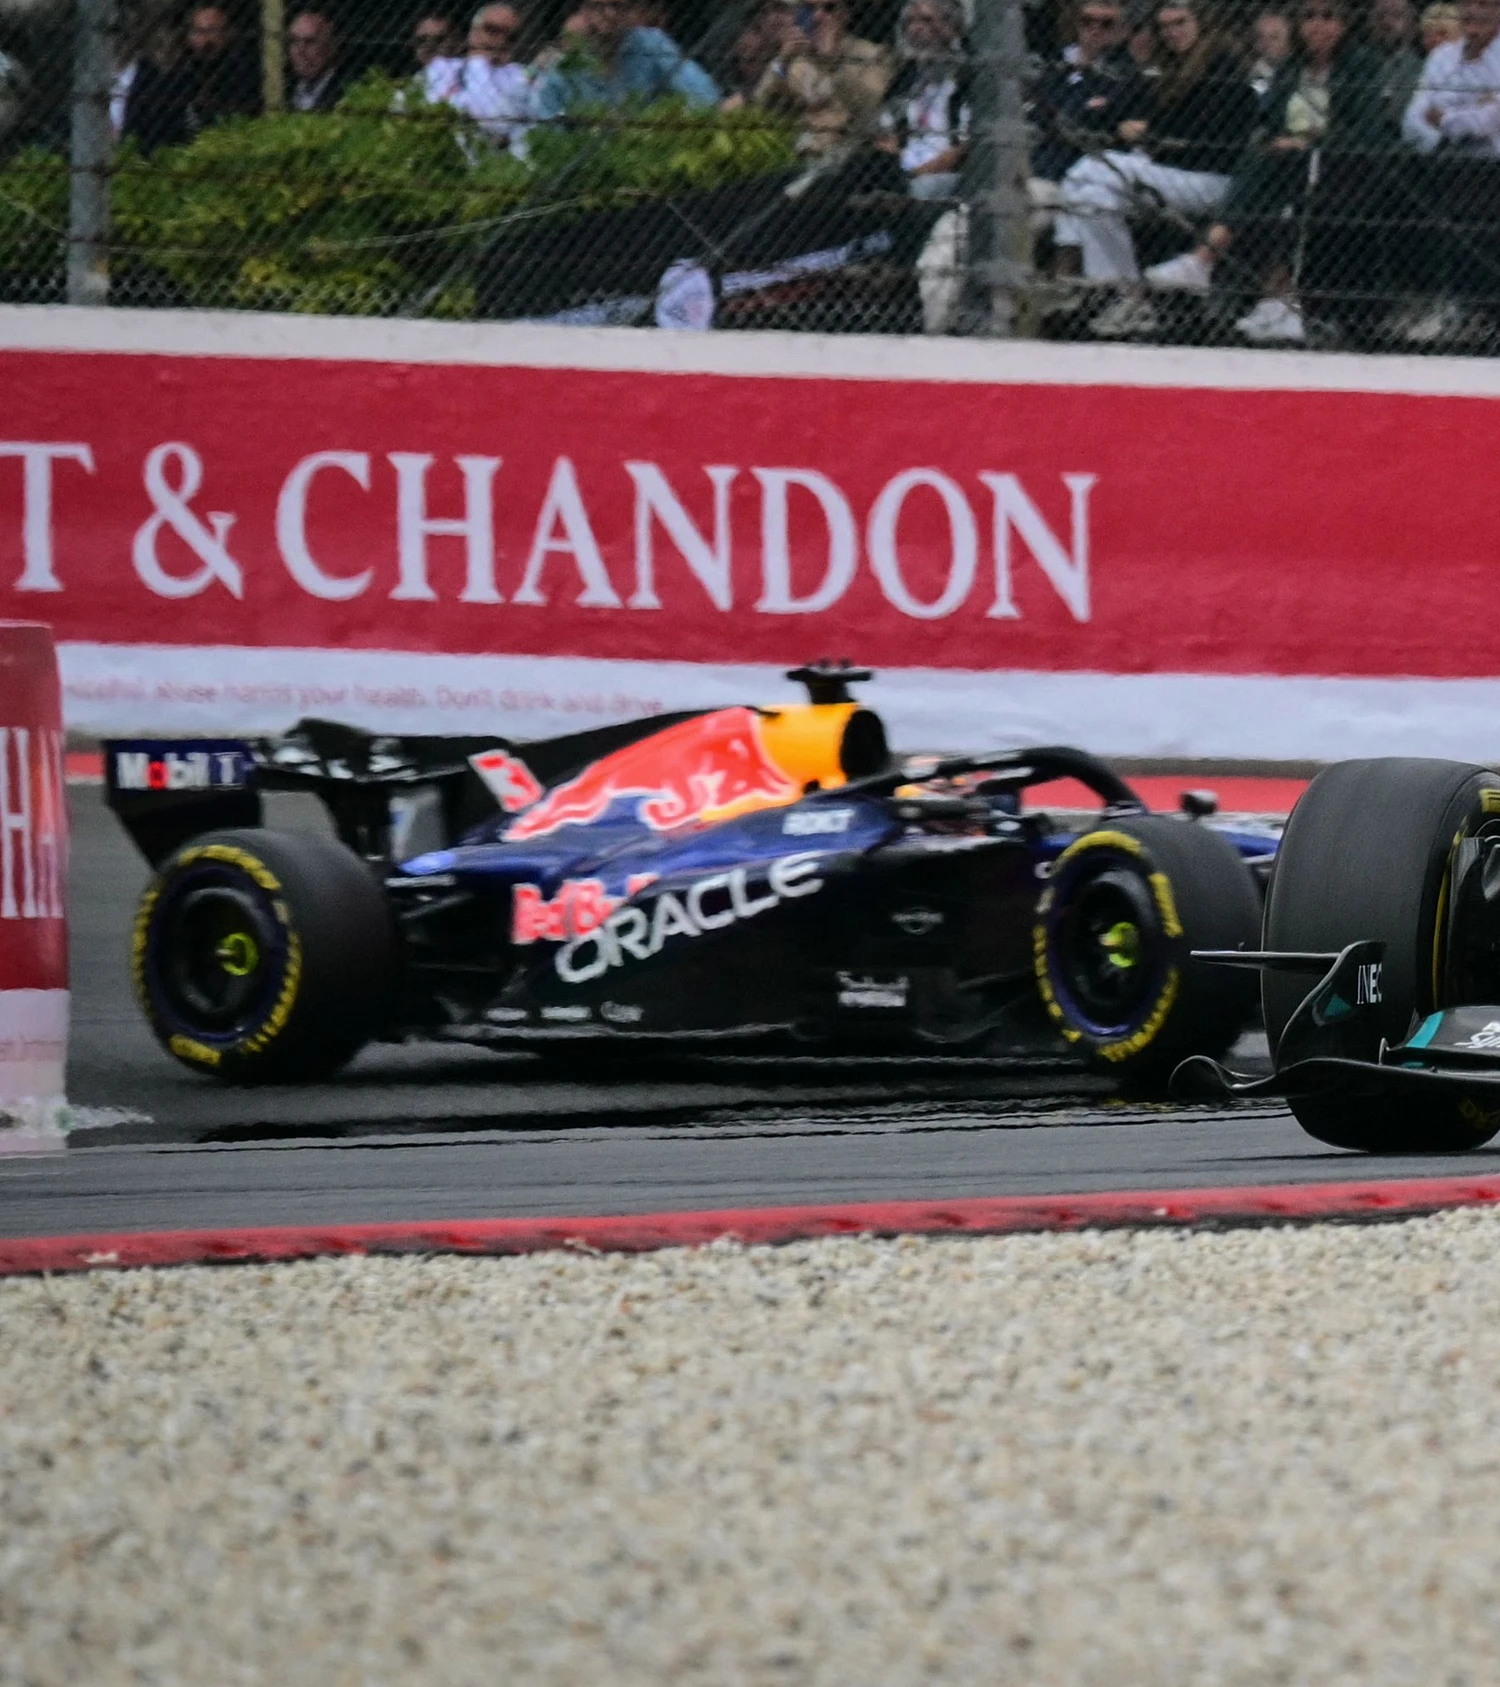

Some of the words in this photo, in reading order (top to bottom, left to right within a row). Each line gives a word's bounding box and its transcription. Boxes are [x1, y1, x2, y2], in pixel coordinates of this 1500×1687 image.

[132, 441, 244, 599] &
[275, 450, 1100, 622] CHANDON
[116, 751, 209, 791] Mobil
[554, 851, 824, 984] ORACLE
